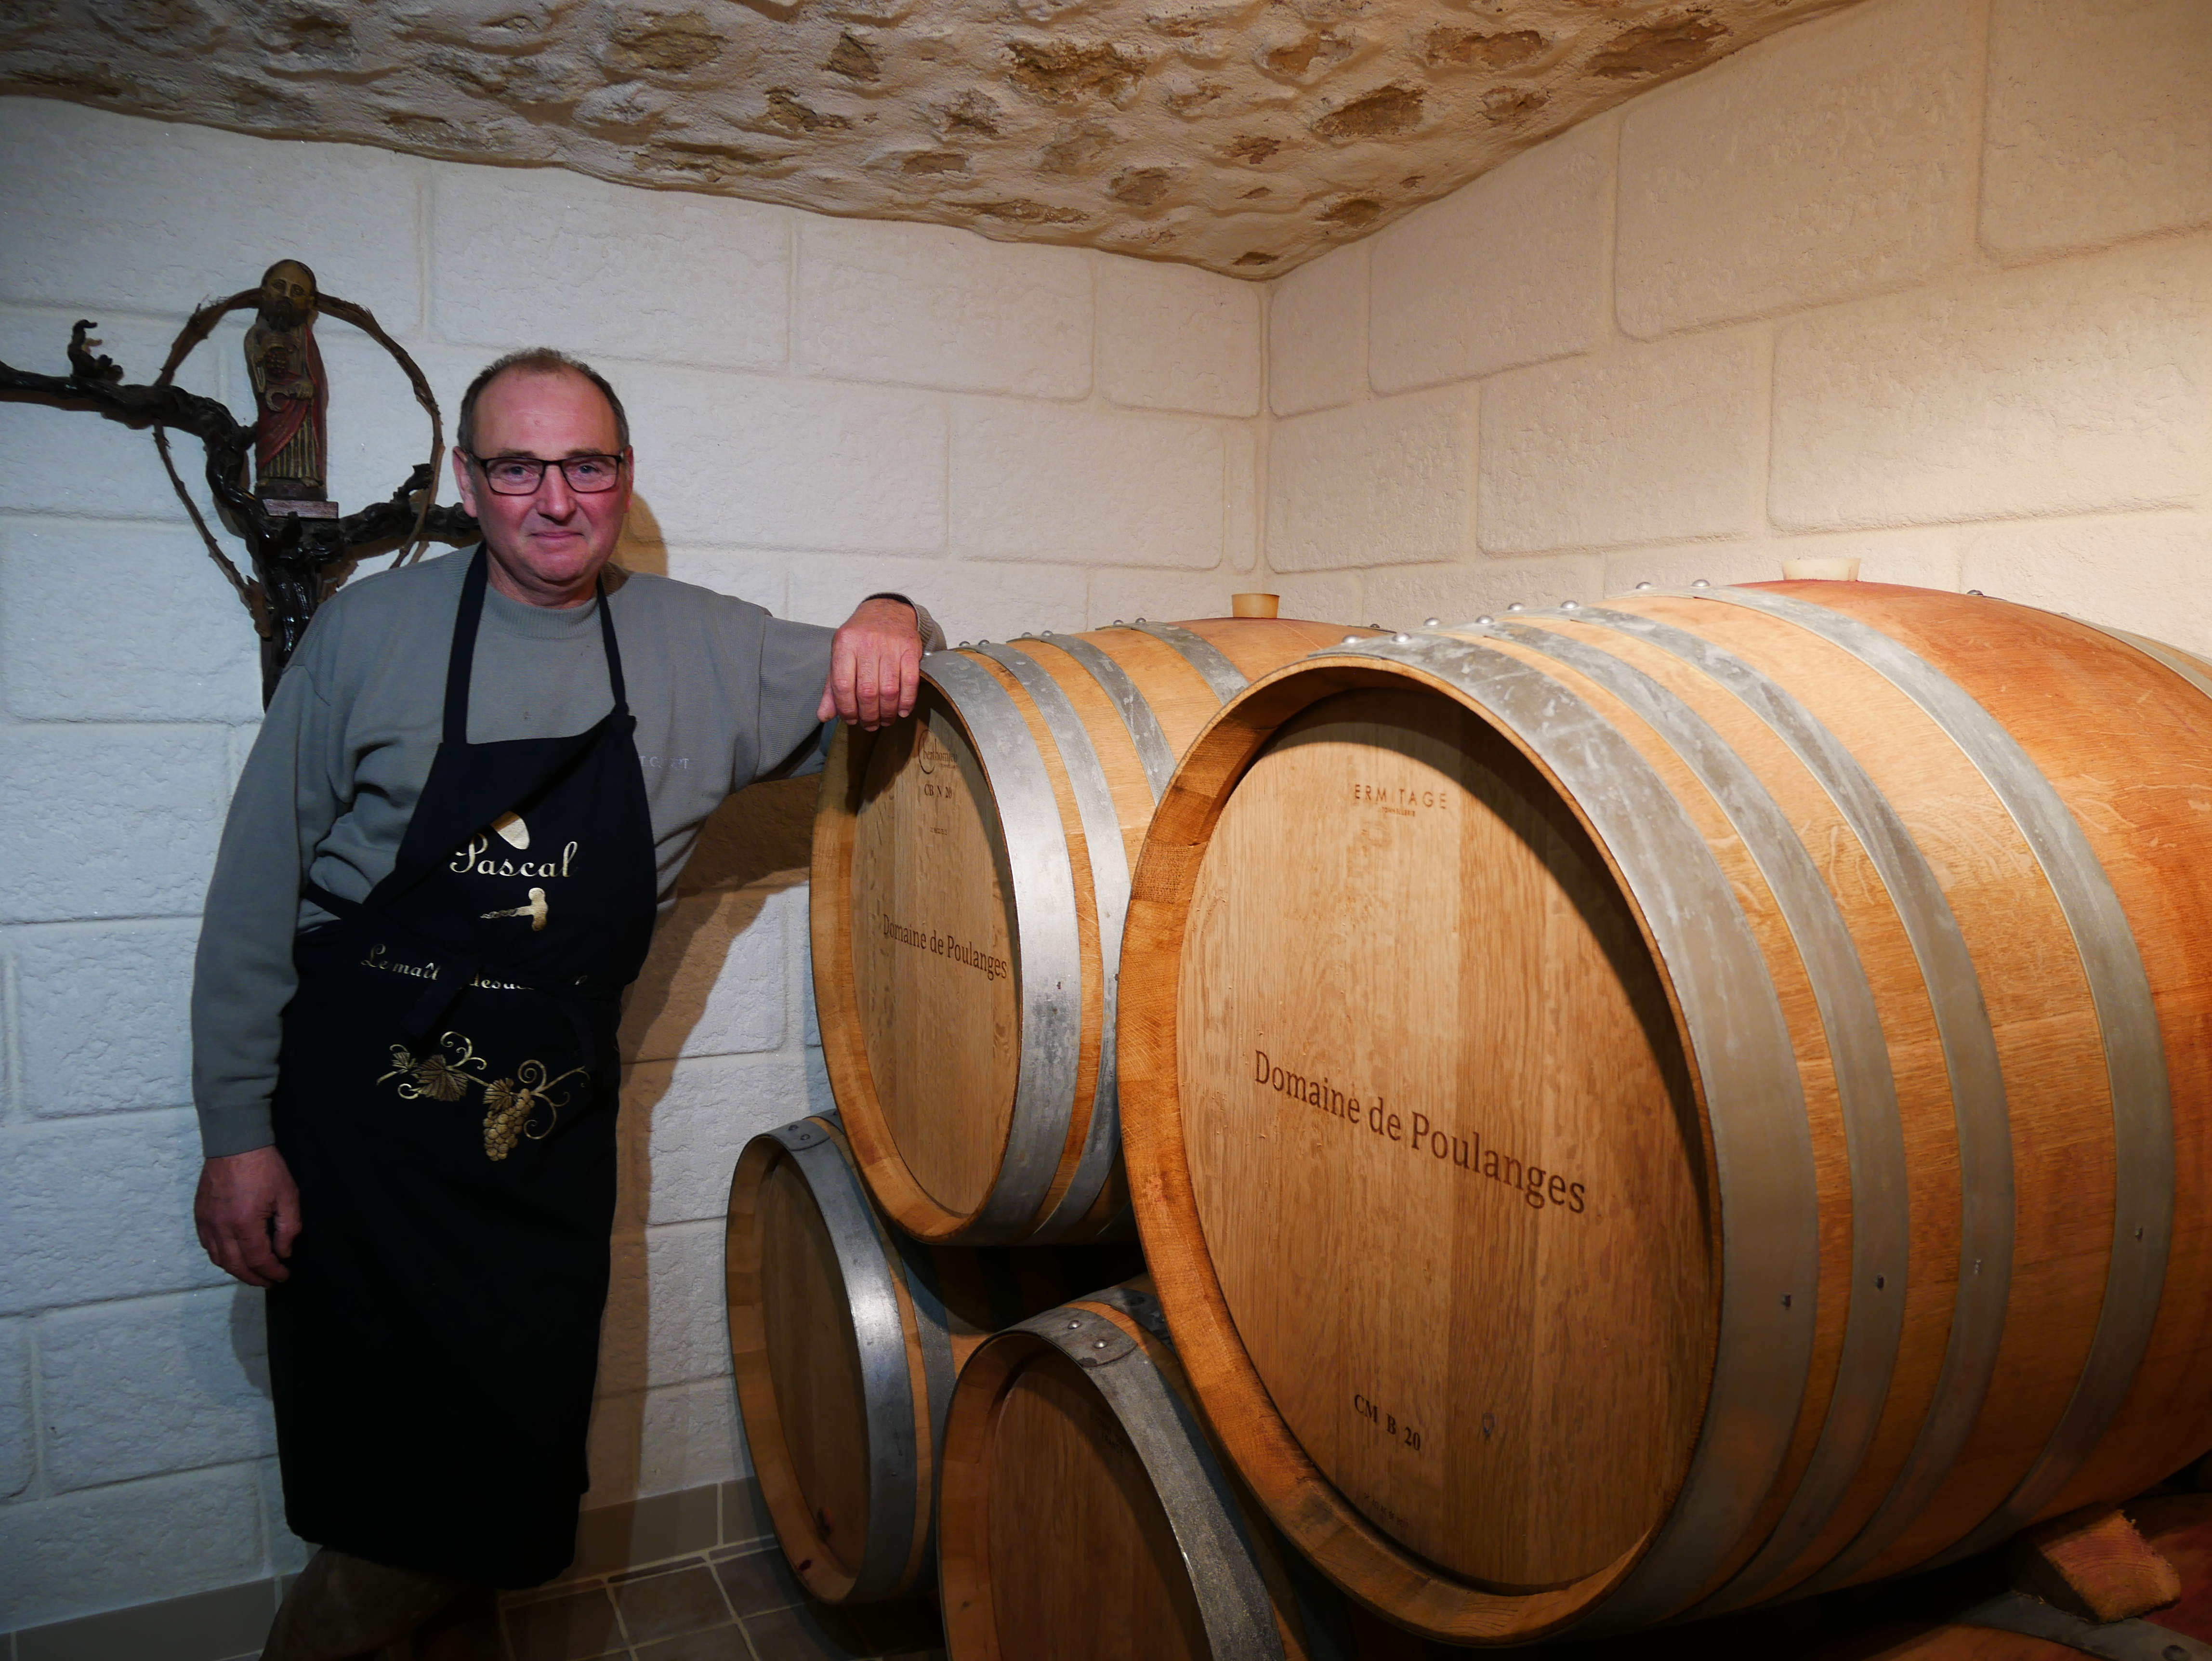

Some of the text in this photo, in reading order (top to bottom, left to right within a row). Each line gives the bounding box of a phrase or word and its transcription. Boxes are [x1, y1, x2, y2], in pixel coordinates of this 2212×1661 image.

[924, 783, 934, 796] CB
[945, 786, 952, 799] 20
[1354, 784, 1446, 810] ERMITAGE
[448, 832, 578, 878] Pascal
[360, 944, 392, 970] Le
[392, 962, 441, 981] maît
[883, 913, 1008, 981] Domaine de Poulanges
[1254, 1049, 1585, 1214] Domaine de Poulanges
[1354, 1394, 1421, 1451] CM B 20
